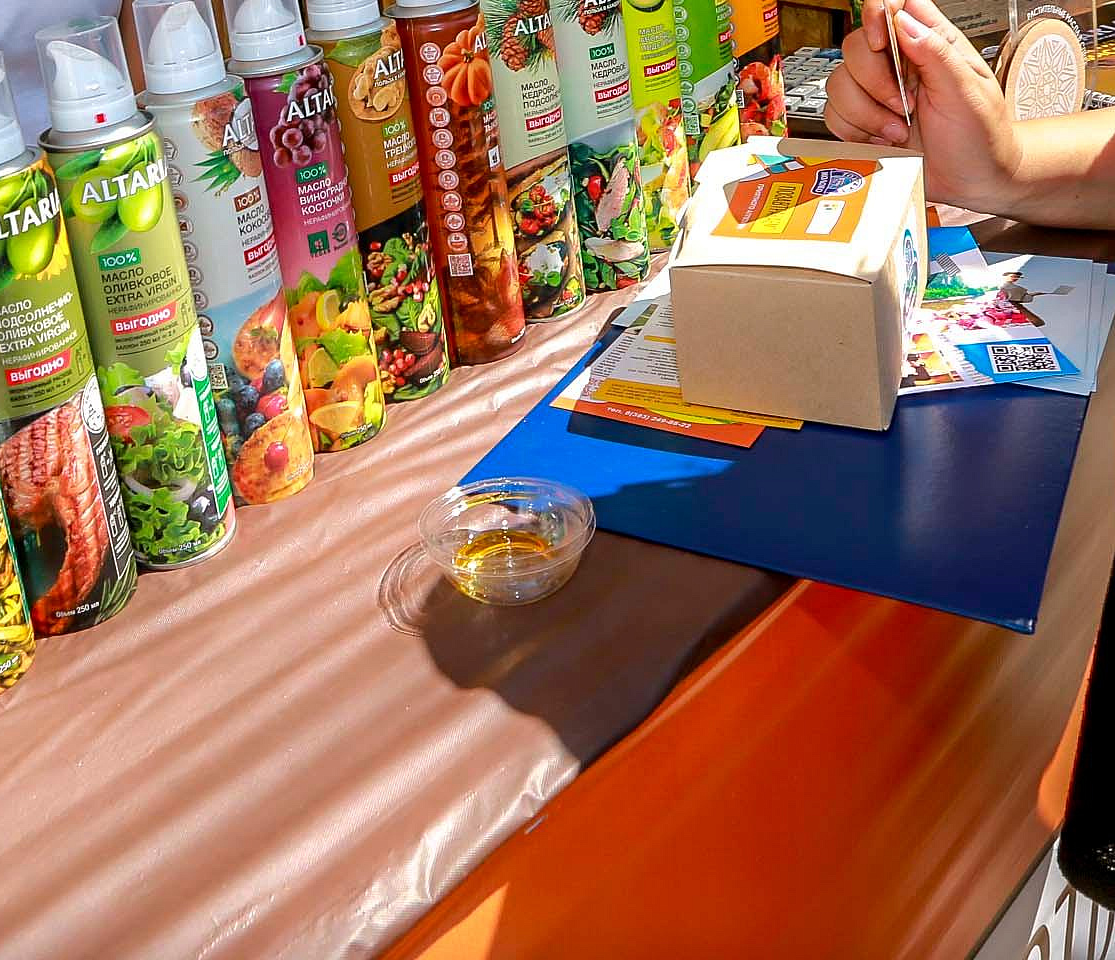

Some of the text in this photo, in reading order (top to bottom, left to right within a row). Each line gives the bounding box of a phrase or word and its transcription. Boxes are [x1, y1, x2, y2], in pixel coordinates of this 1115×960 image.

[513, 13, 552, 37] ALTA
[592, 46, 614, 58] 100%
[591, 57, 617, 71] МАСЛО
[521, 78, 548, 92] МАСЛО
[597, 83, 628, 101] ВЫГОДНО
[385, 121, 407, 136] 100%
[384, 131, 410, 149] МАСЛО
[299, 165, 327, 180] 100%
[297, 176, 332, 195] МАСЛО
[236, 189, 261, 208] 100%
[237, 203, 265, 225] МАСЛО
[101, 252, 138, 268] 100%
[101, 266, 144, 284] МАСЛО
[103, 265, 173, 295] ОЛИВКОВОЕ
[106, 275, 178, 307] EXTRA VIRGIN
[115, 307, 171, 333] ВЫГОДНО
[36, 319, 72, 345] VIRGIN
[139, 337, 152, 347] 250
[10, 355, 65, 382] ВЫГОДНО
[178, 541, 193, 551] 250
[55, 609, 75, 618] Объем
[75, 602, 91, 615] 250
